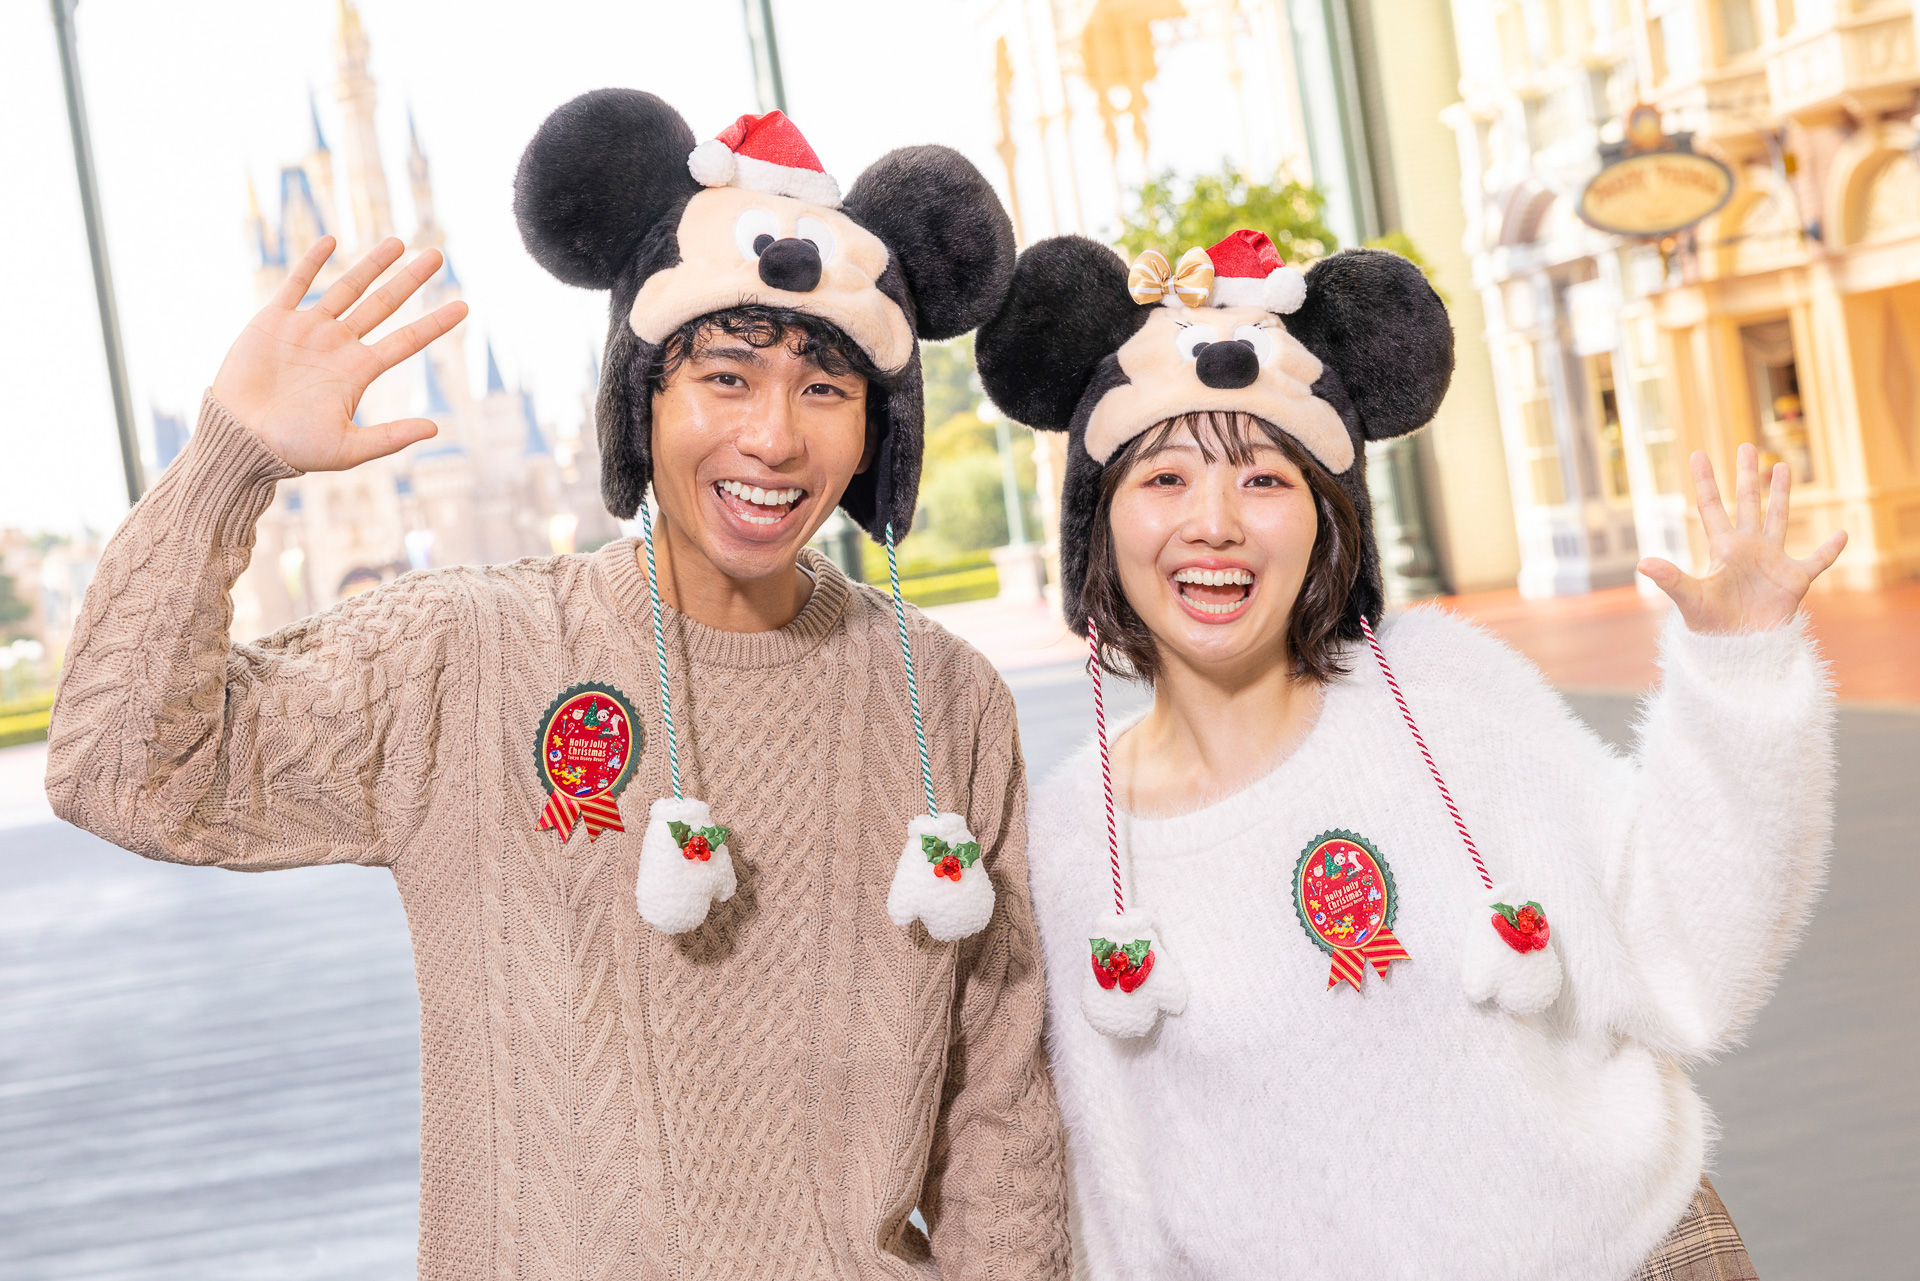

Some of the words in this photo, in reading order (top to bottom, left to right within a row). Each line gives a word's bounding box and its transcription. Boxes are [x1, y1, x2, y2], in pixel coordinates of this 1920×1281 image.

[569, 738, 588, 748] Holly
[590, 740, 607, 749] Jolly
[569, 747, 606, 757] Christmas
[1325, 889, 1342, 903] Holly
[1342, 881, 1359, 894] Jolly
[1328, 889, 1363, 910] Christmas
